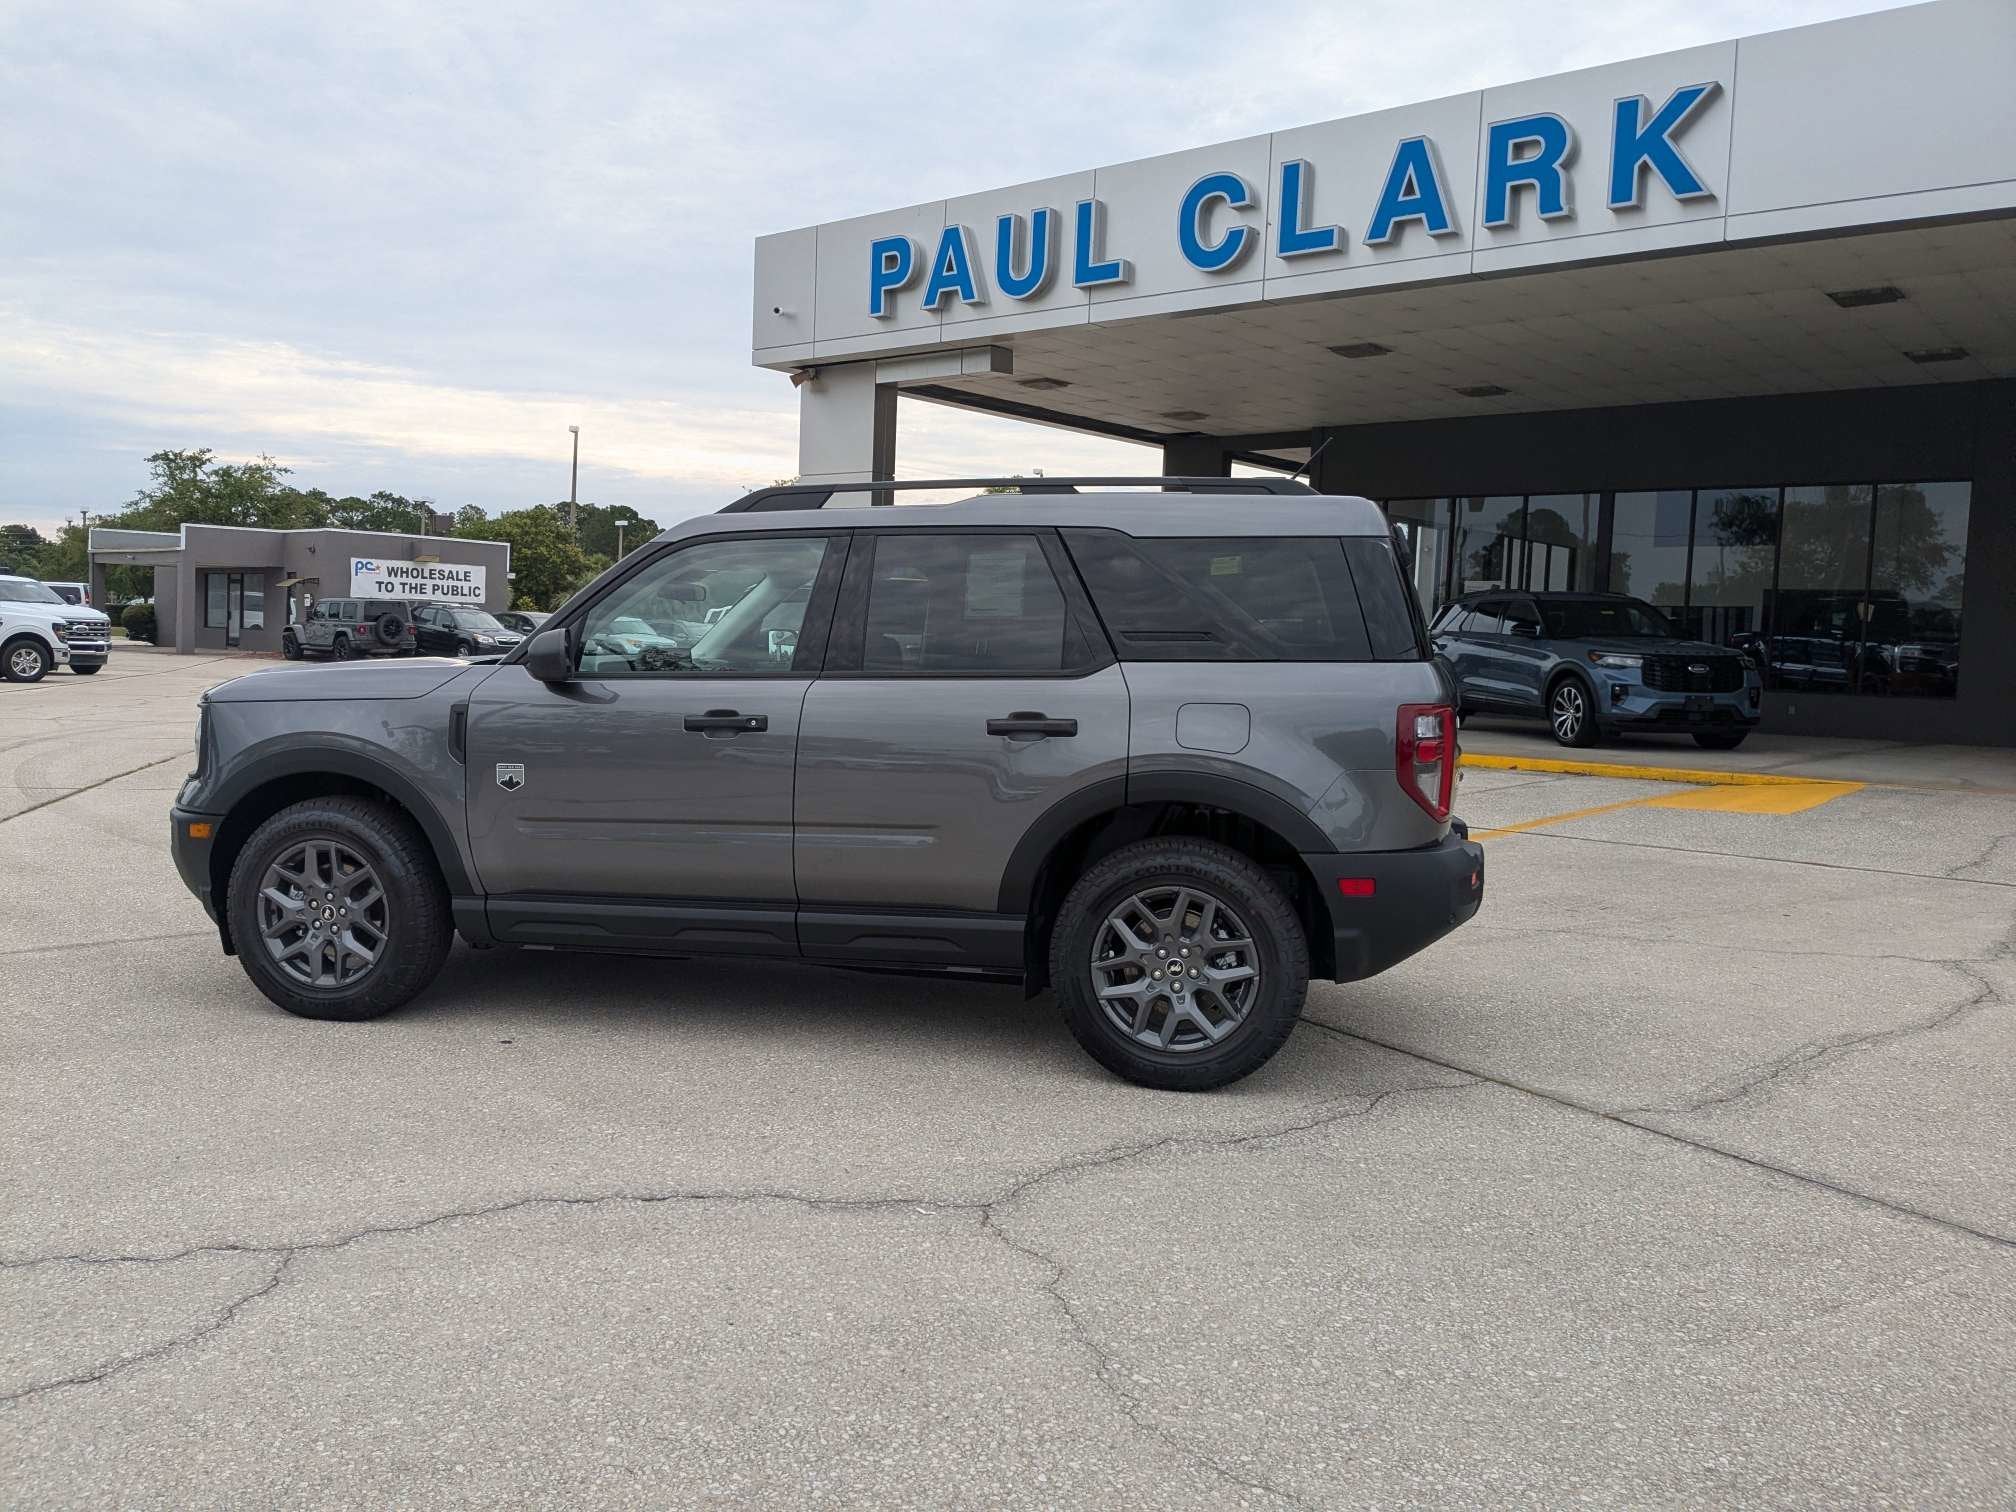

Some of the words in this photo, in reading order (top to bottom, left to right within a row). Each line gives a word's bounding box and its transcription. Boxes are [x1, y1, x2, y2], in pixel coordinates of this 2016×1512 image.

[868, 199, 1128, 319] PAUL
[1177, 81, 1722, 273] CLARK
[386, 566, 472, 583] WHOLESALE
[376, 581, 395, 593] TO
[400, 582, 427, 595] THE
[432, 584, 481, 598] PUBLIC
